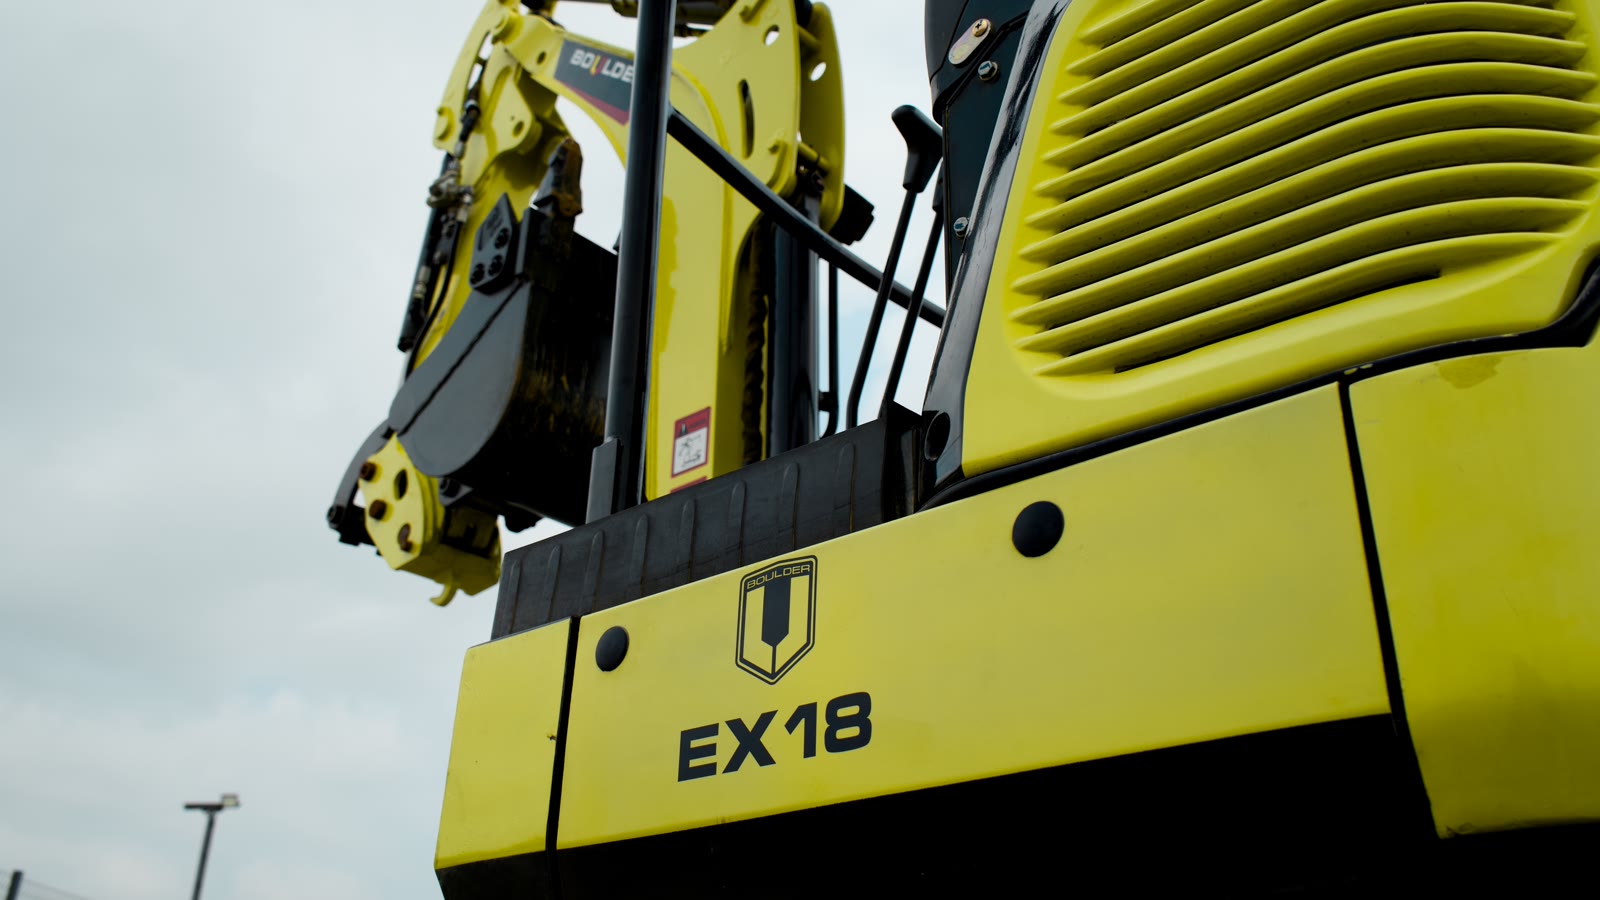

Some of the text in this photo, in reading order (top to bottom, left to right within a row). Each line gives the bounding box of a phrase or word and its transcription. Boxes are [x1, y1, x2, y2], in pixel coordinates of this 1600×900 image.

[570, 48, 634, 83] BOULDE
[746, 564, 811, 590] BOULDER
[677, 691, 873, 782] EX18
